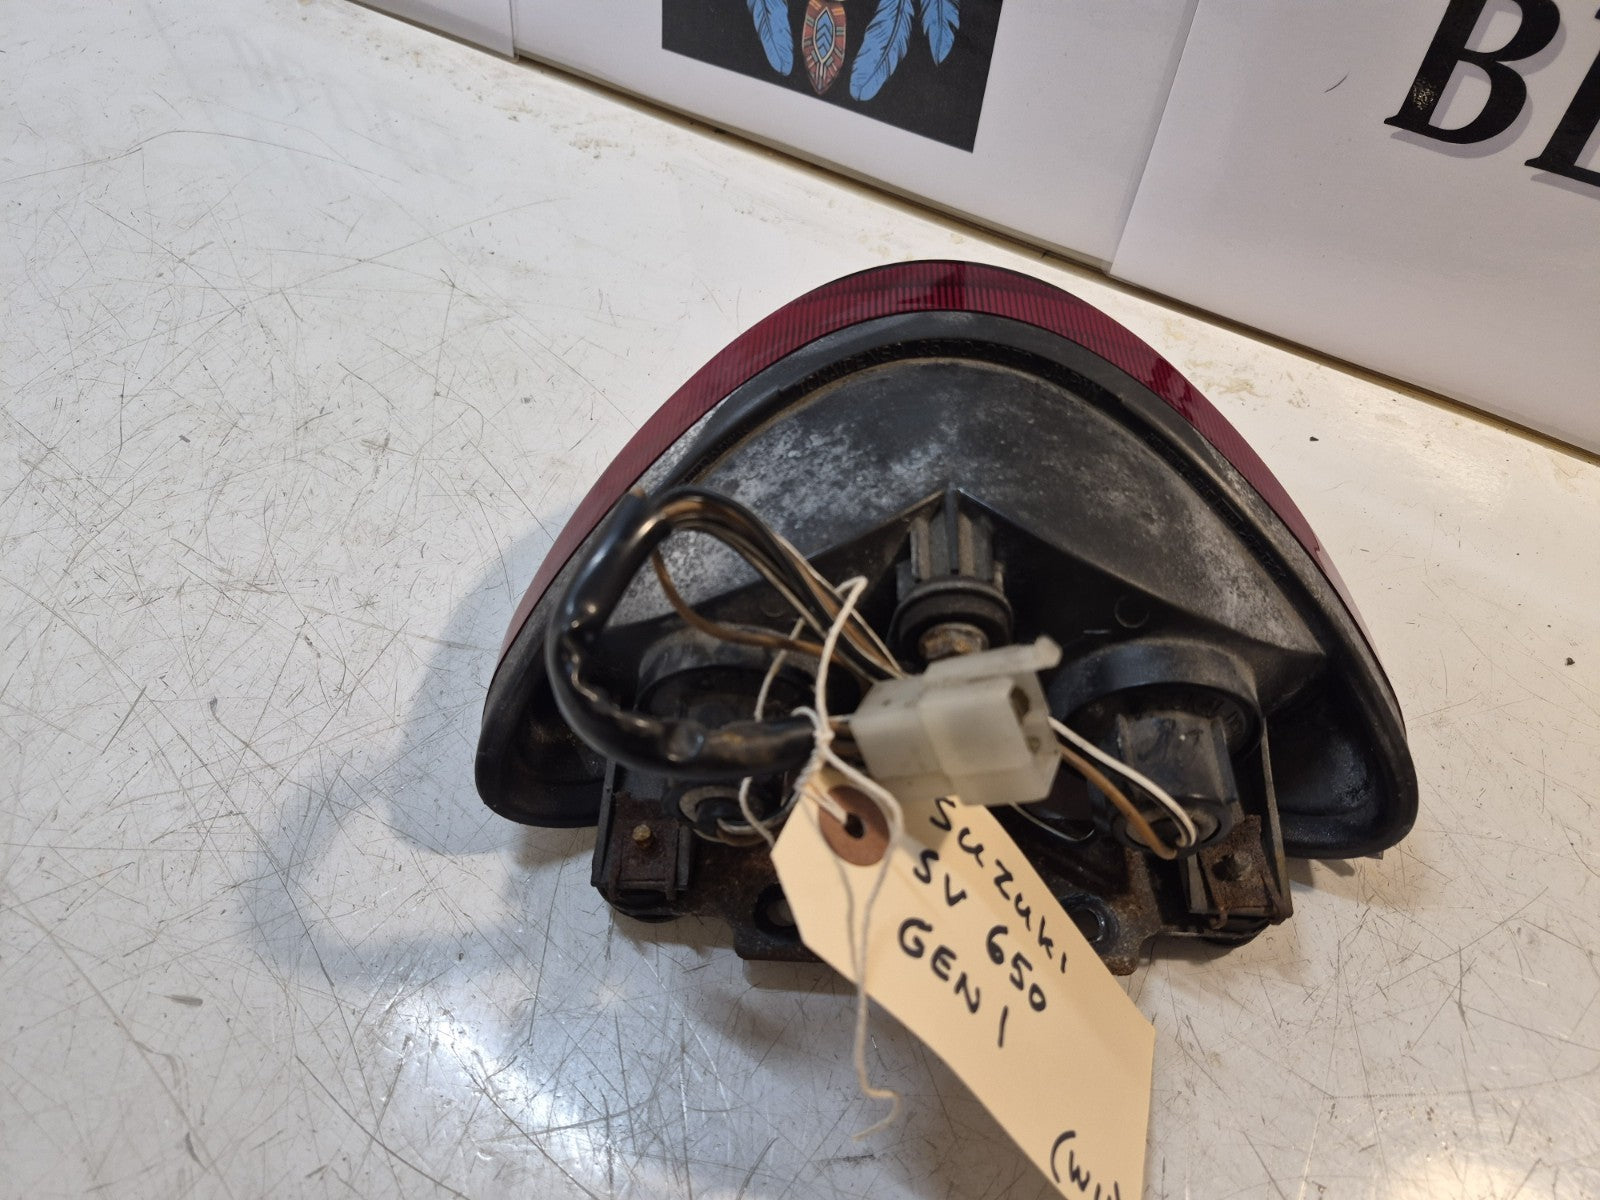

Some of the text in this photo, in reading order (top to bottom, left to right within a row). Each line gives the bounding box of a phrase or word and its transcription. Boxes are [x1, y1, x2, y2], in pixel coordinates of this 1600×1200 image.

[898, 917, 981, 1013] GEN
[913, 849, 1047, 1012] SV 650
